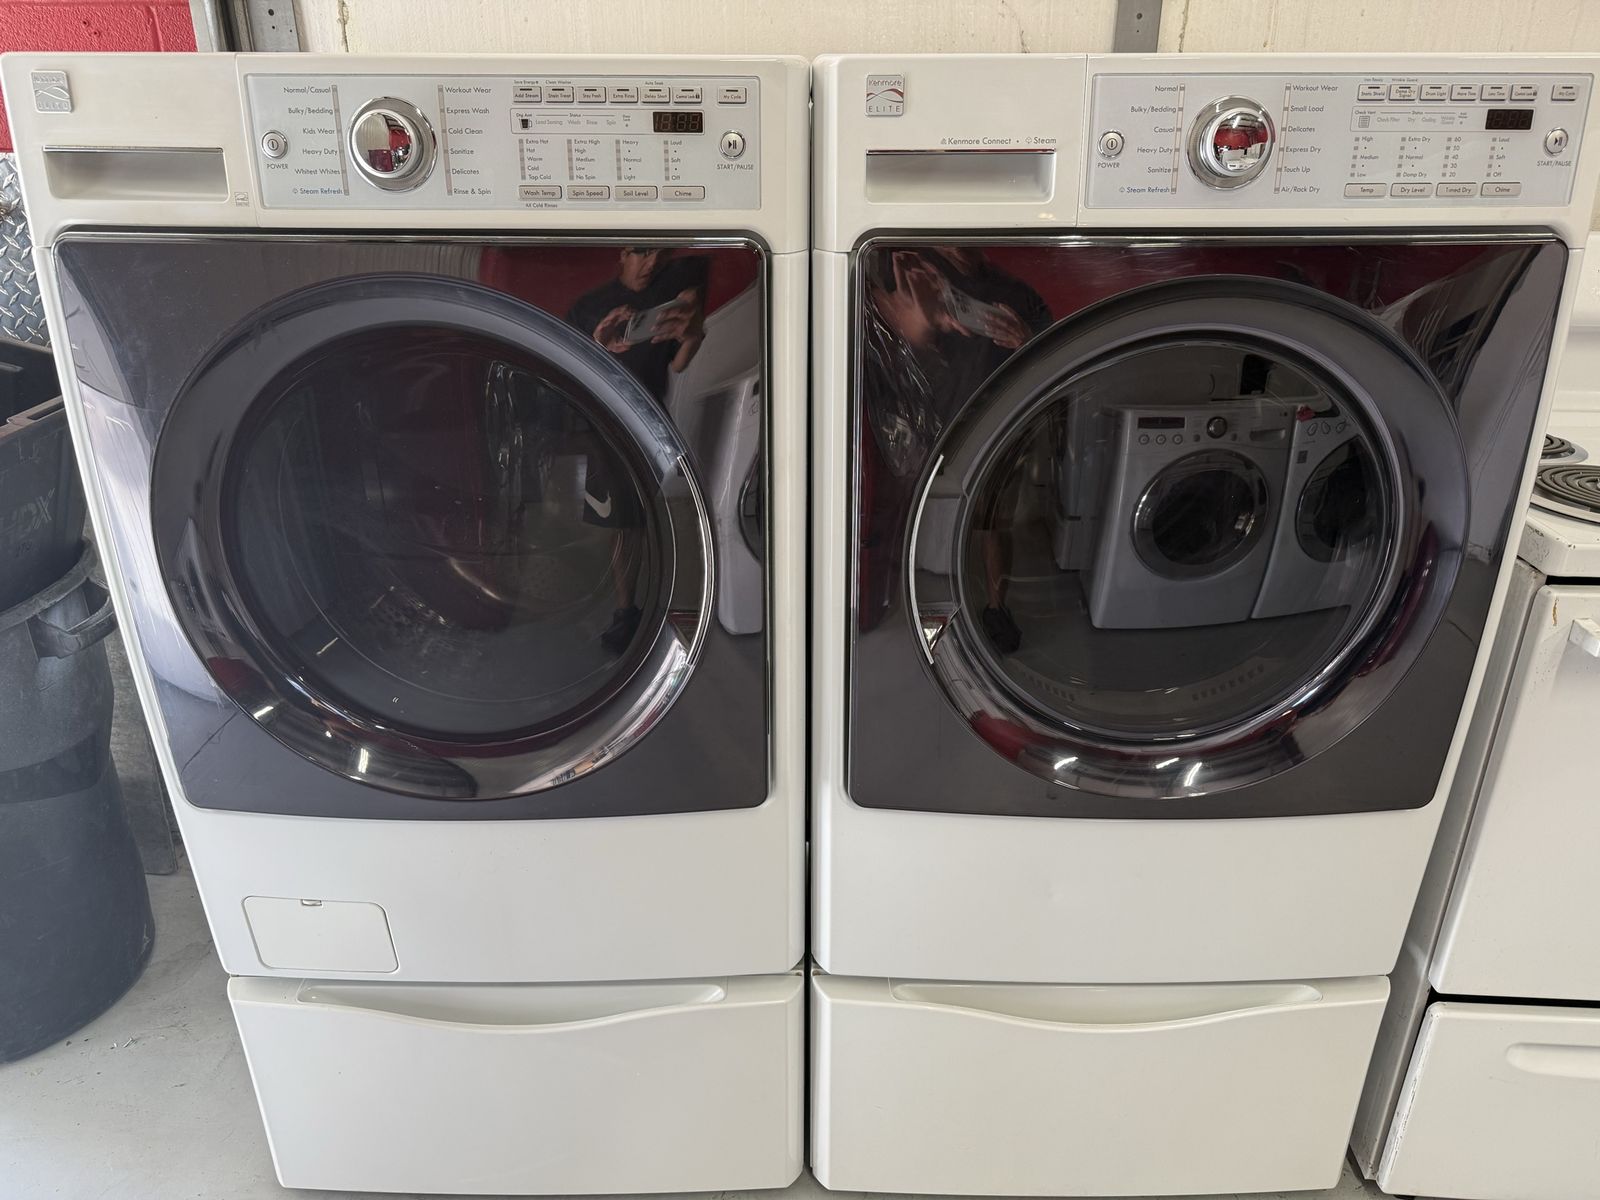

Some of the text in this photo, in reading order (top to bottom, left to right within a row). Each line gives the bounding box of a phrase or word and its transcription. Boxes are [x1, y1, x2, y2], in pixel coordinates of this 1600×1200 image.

[284, 86, 331, 95] Normal/Casual
[288, 107, 333, 116] Bulky/Bedding
[1131, 105, 1176, 114] Bulky/Bedding
[948, 136, 1011, 145] Kenmore Connect
[302, 148, 338, 156] Heavy Duty
[1137, 147, 1173, 155] Heavy Duty
[1286, 146, 1321, 154] Express Dry
[320, 187, 343, 195] Refresh
[477, 188, 492, 196] Spin
[1148, 186, 1170, 194] Refresh
[1281, 186, 1320, 194] Air/Rack Dry
